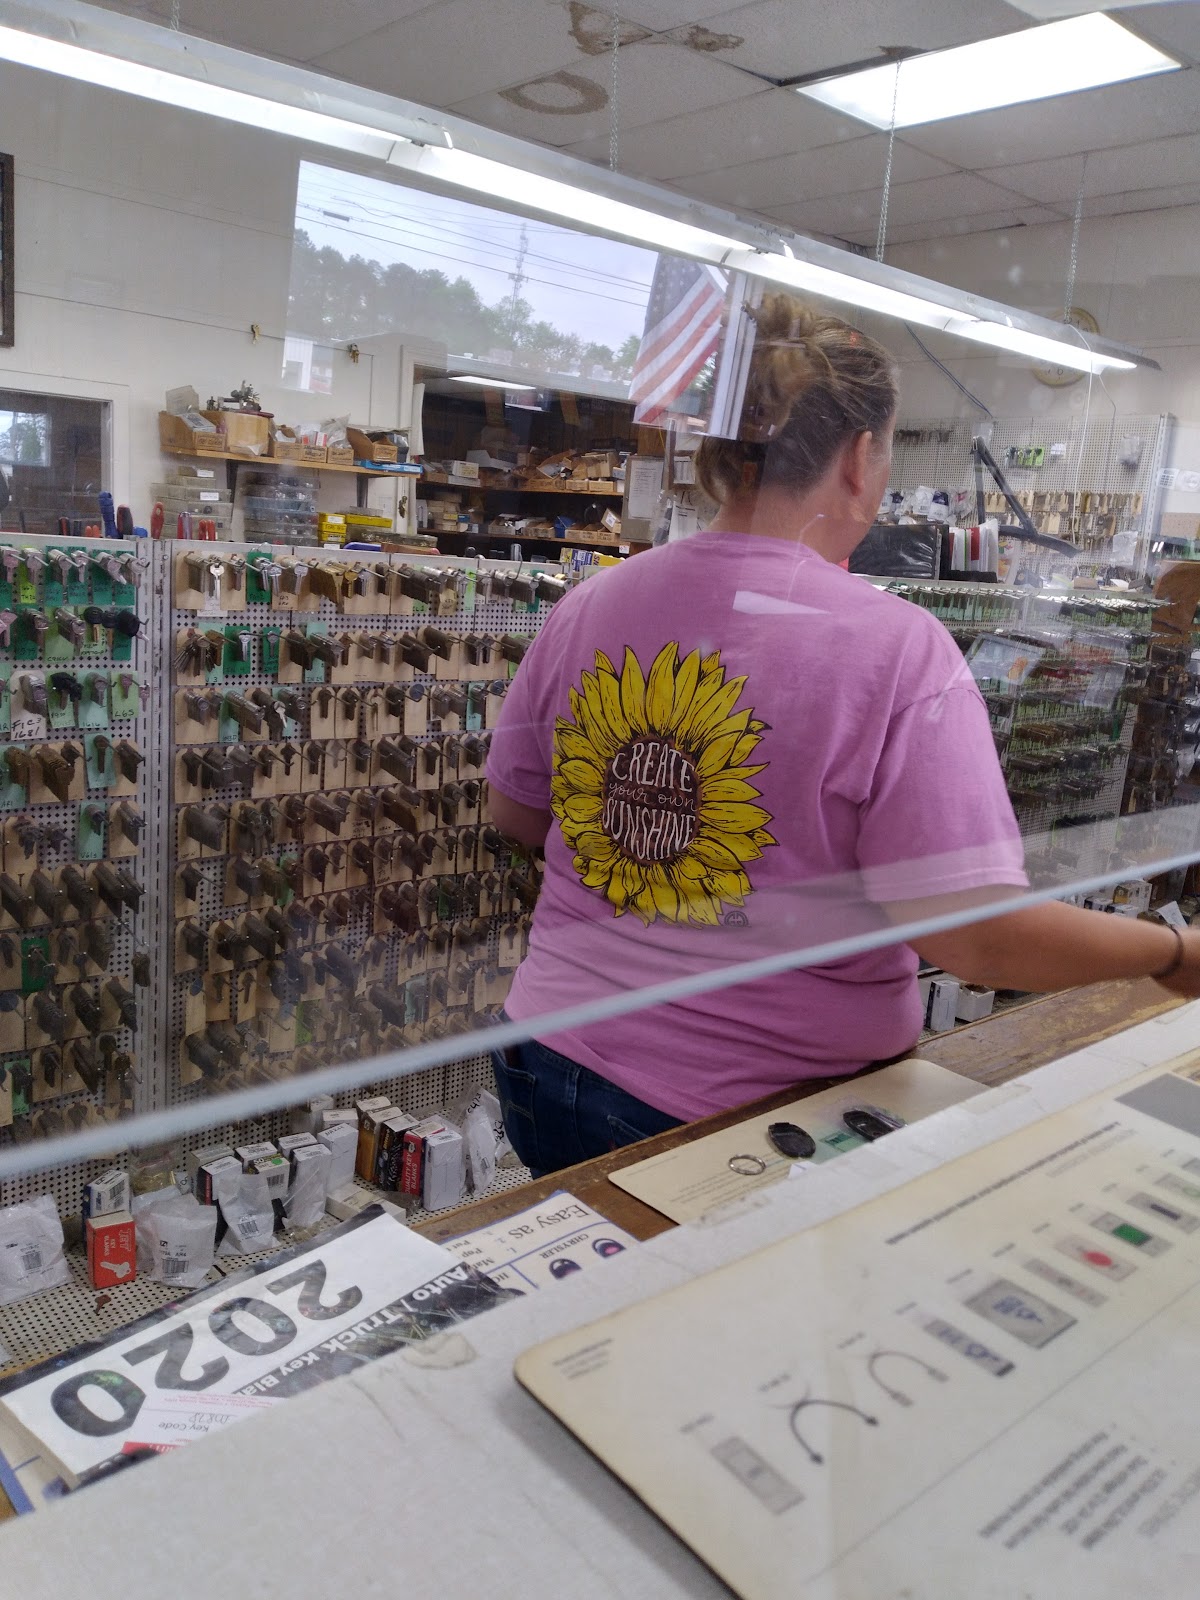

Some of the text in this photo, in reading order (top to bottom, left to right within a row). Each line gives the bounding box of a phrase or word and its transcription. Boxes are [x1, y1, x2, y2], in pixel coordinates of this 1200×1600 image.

[612, 742, 695, 792] CREATE
[609, 782, 697, 811] your own
[603, 798, 696, 860] SUNSHINE
[508, 1204, 591, 1239] Easy as
[539, 1233, 590, 1259] CHRYSLER
[412, 1266, 470, 1301] Auto
[320, 1306, 404, 1354] Truck
[50, 1259, 363, 1437] 2020
[279, 1351, 320, 1377] Key
[158, 1421, 209, 1432] Key Code
